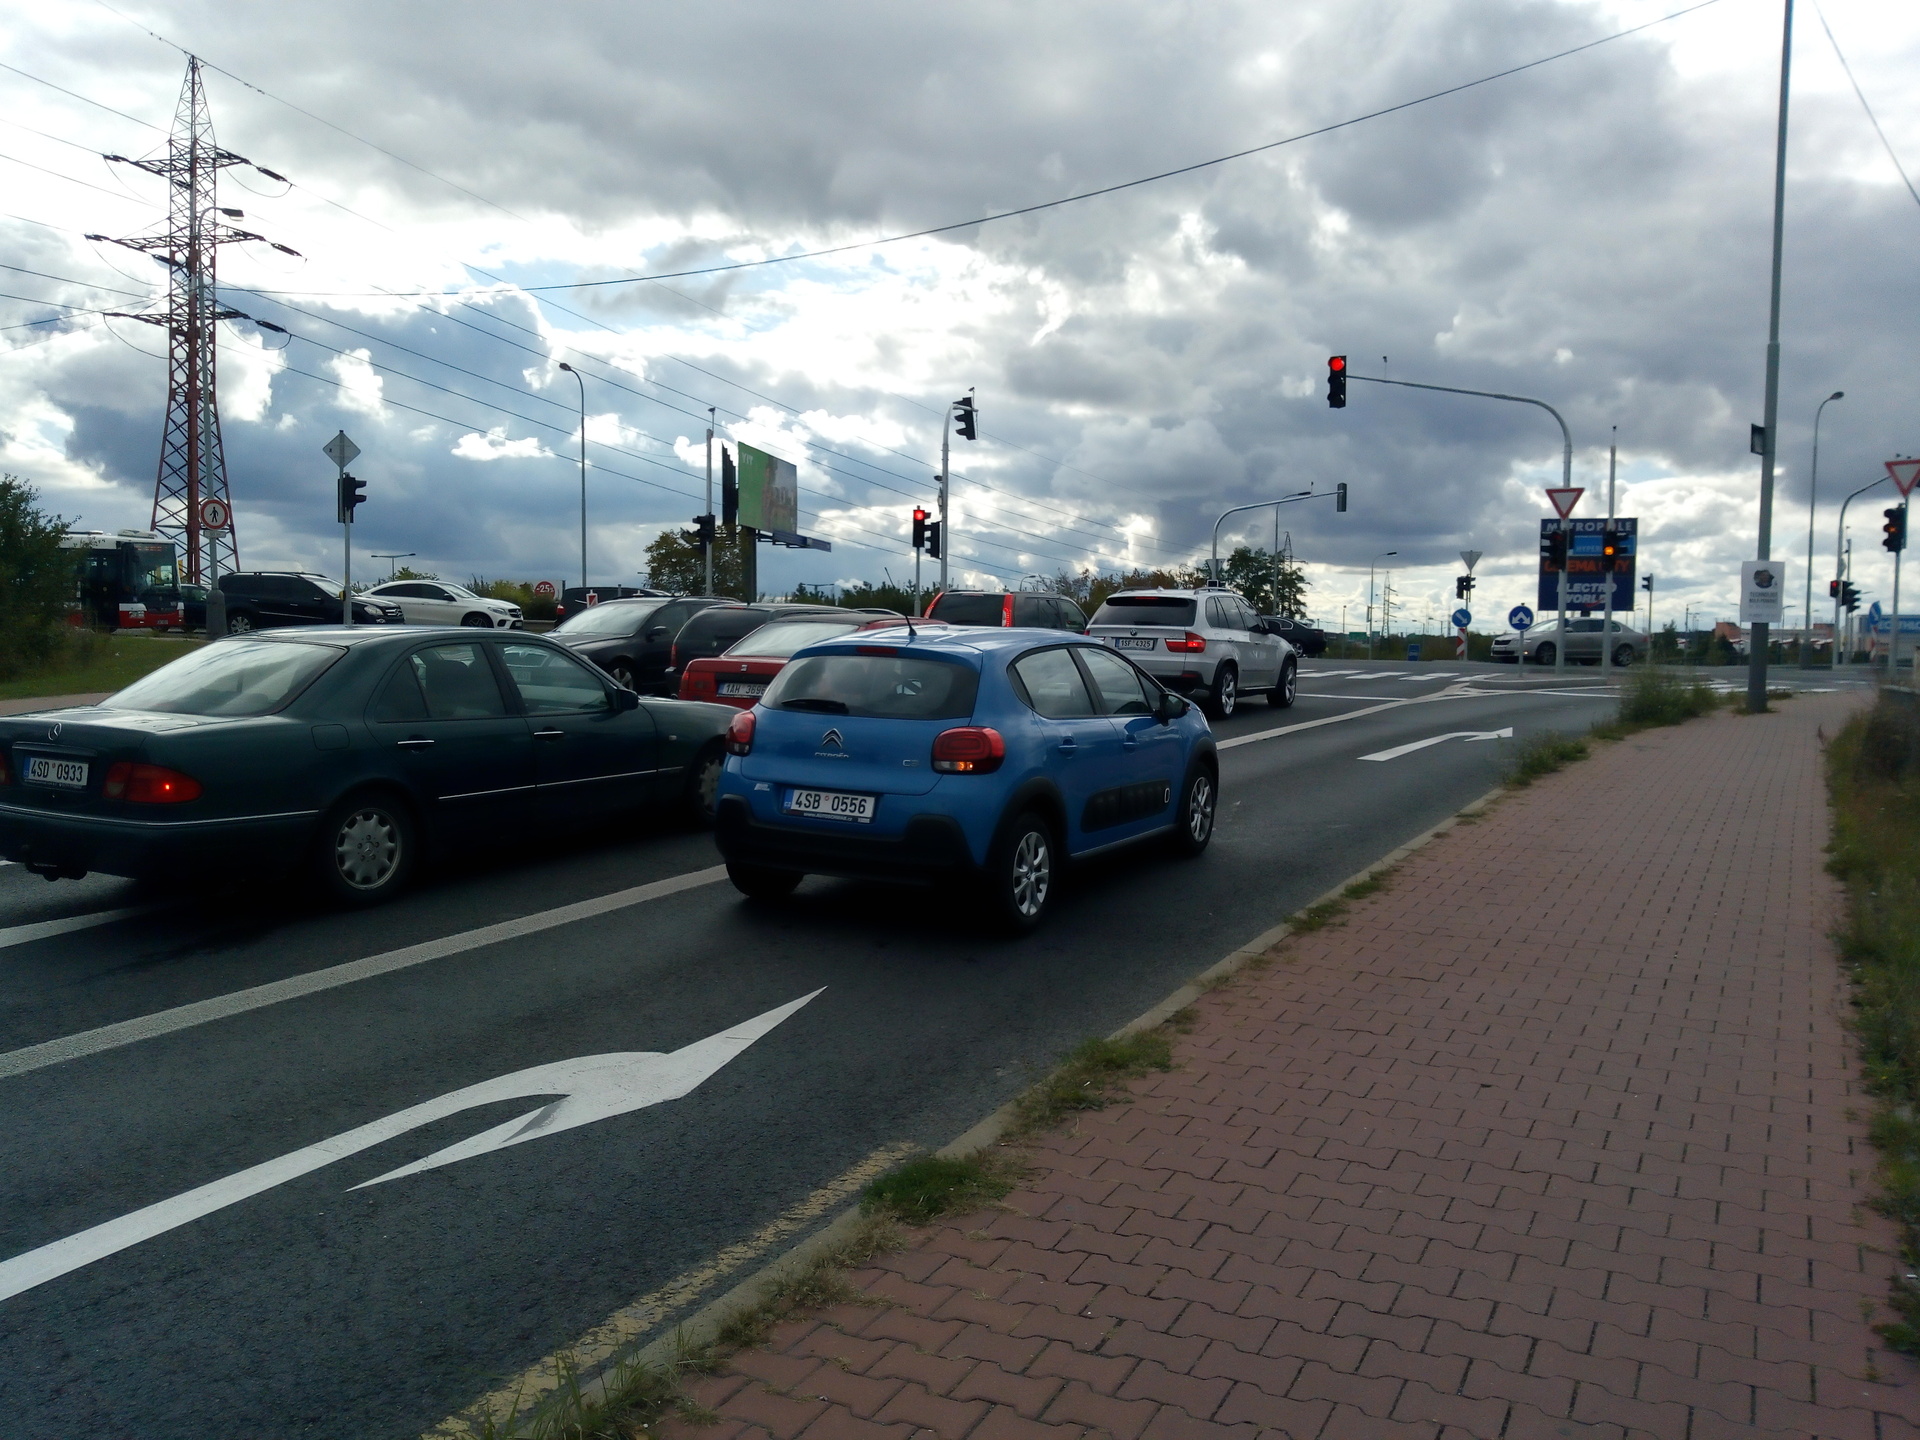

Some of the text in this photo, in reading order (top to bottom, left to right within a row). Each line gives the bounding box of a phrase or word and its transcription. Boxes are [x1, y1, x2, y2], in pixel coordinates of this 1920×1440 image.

[1546, 521, 1633, 532] MTROPLE
[726, 684, 740, 695] 1AH
[30, 760, 50, 778] 4SD
[56, 763, 83, 782] 0933
[795, 792, 821, 810] 4SB
[831, 796, 867, 814] 0556
